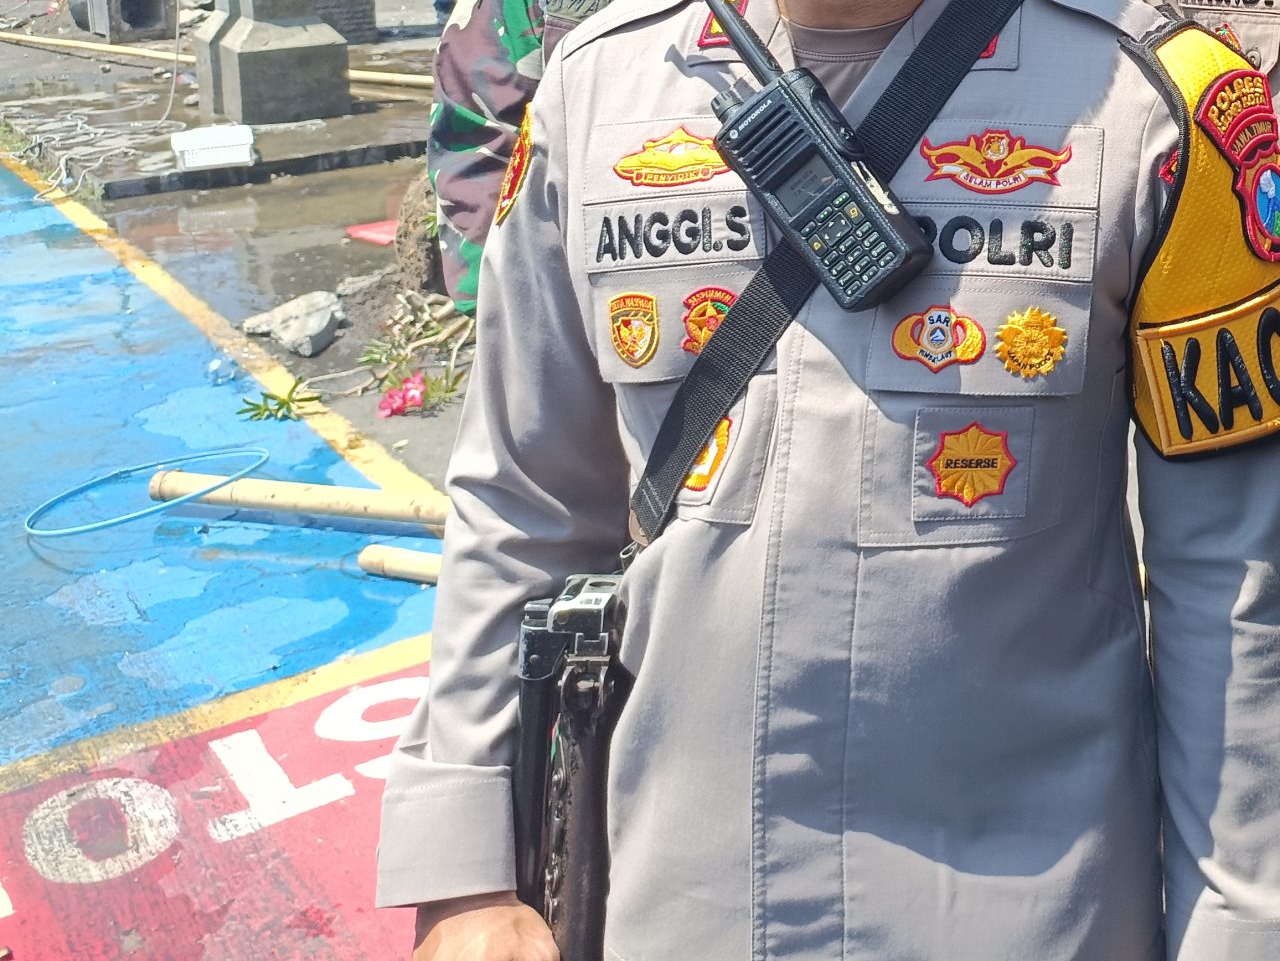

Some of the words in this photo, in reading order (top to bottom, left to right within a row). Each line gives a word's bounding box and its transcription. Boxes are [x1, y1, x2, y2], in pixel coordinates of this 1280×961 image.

[1207, 76, 1265, 124] POLRES
[1242, 93, 1266, 107] KOTA
[738, 99, 773, 132] MOTOROLA
[1232, 128, 1252, 155] JAWA
[1251, 121, 1273, 138] TIMUR
[646, 170, 700, 182] PENYIDIK
[963, 173, 992, 189] SELAM
[995, 175, 1024, 188] POLRI
[596, 205, 752, 263] ANGGI.S
[928, 314, 950, 327] SAR
[944, 458, 999, 469] RESERSE
